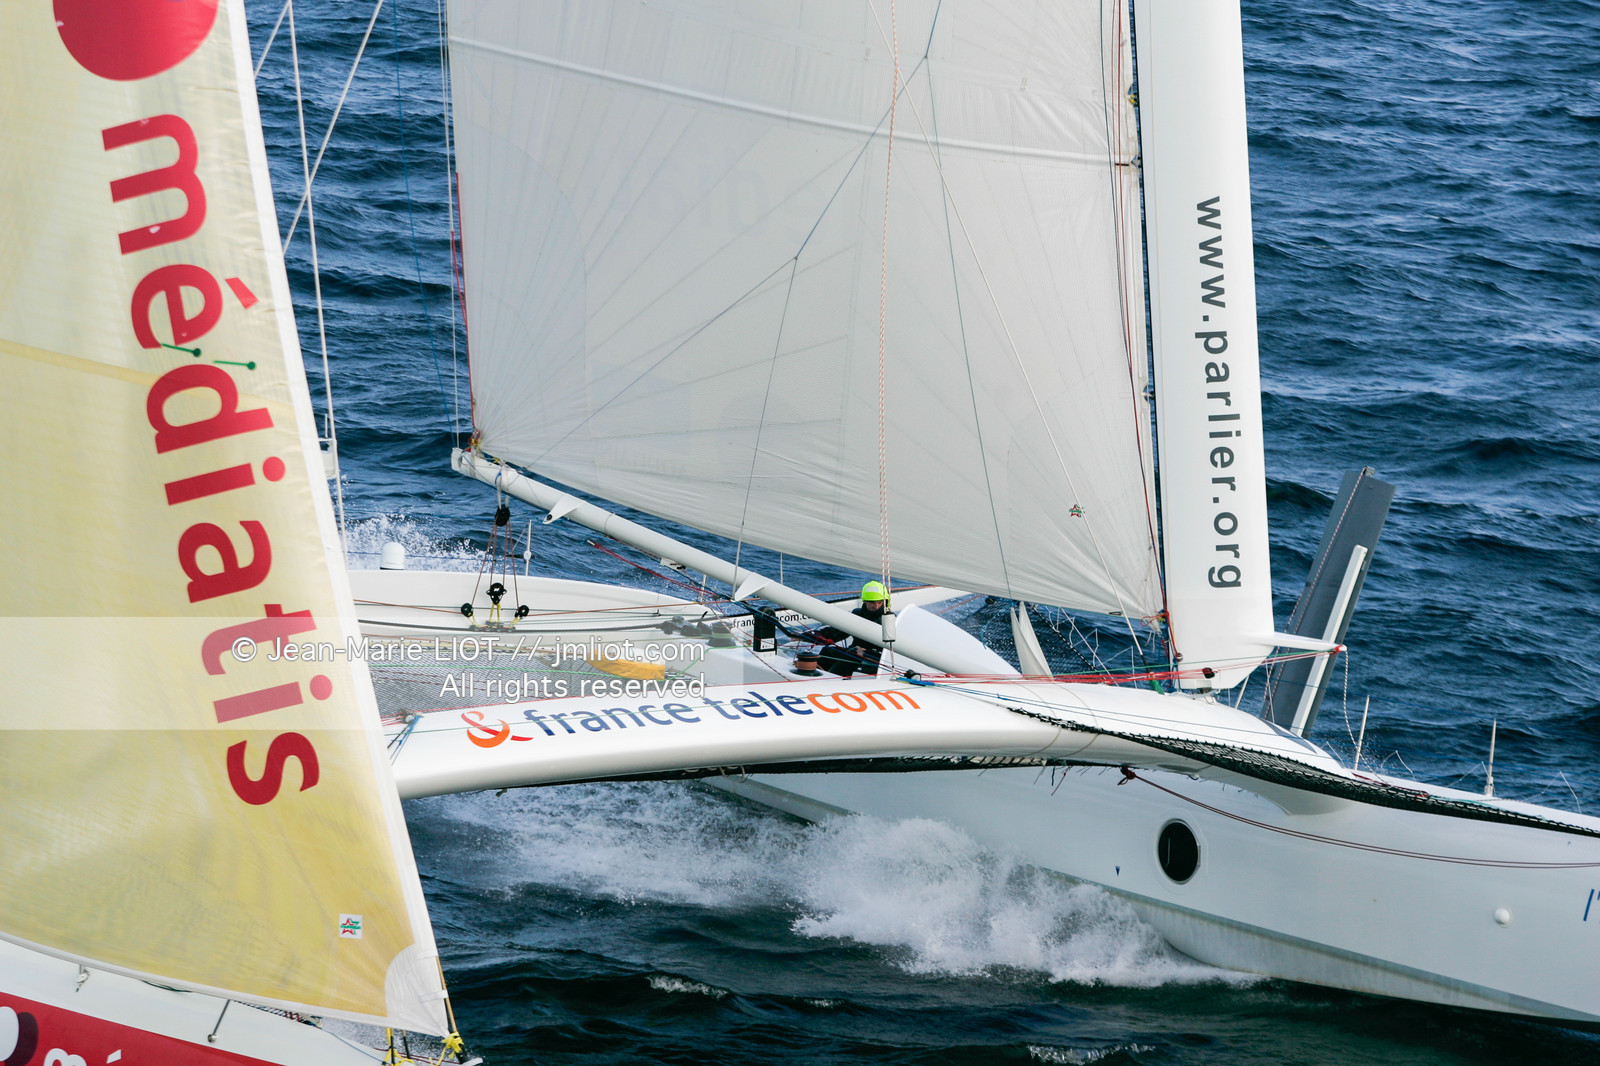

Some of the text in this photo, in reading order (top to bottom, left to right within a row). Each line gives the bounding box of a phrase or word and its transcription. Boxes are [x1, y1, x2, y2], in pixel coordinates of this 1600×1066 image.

[101, 113, 333, 806] médiatis
[1194, 195, 1242, 589] www.parlier.org
[525, 698, 700, 736] france
[702, 689, 922, 720] telecom
